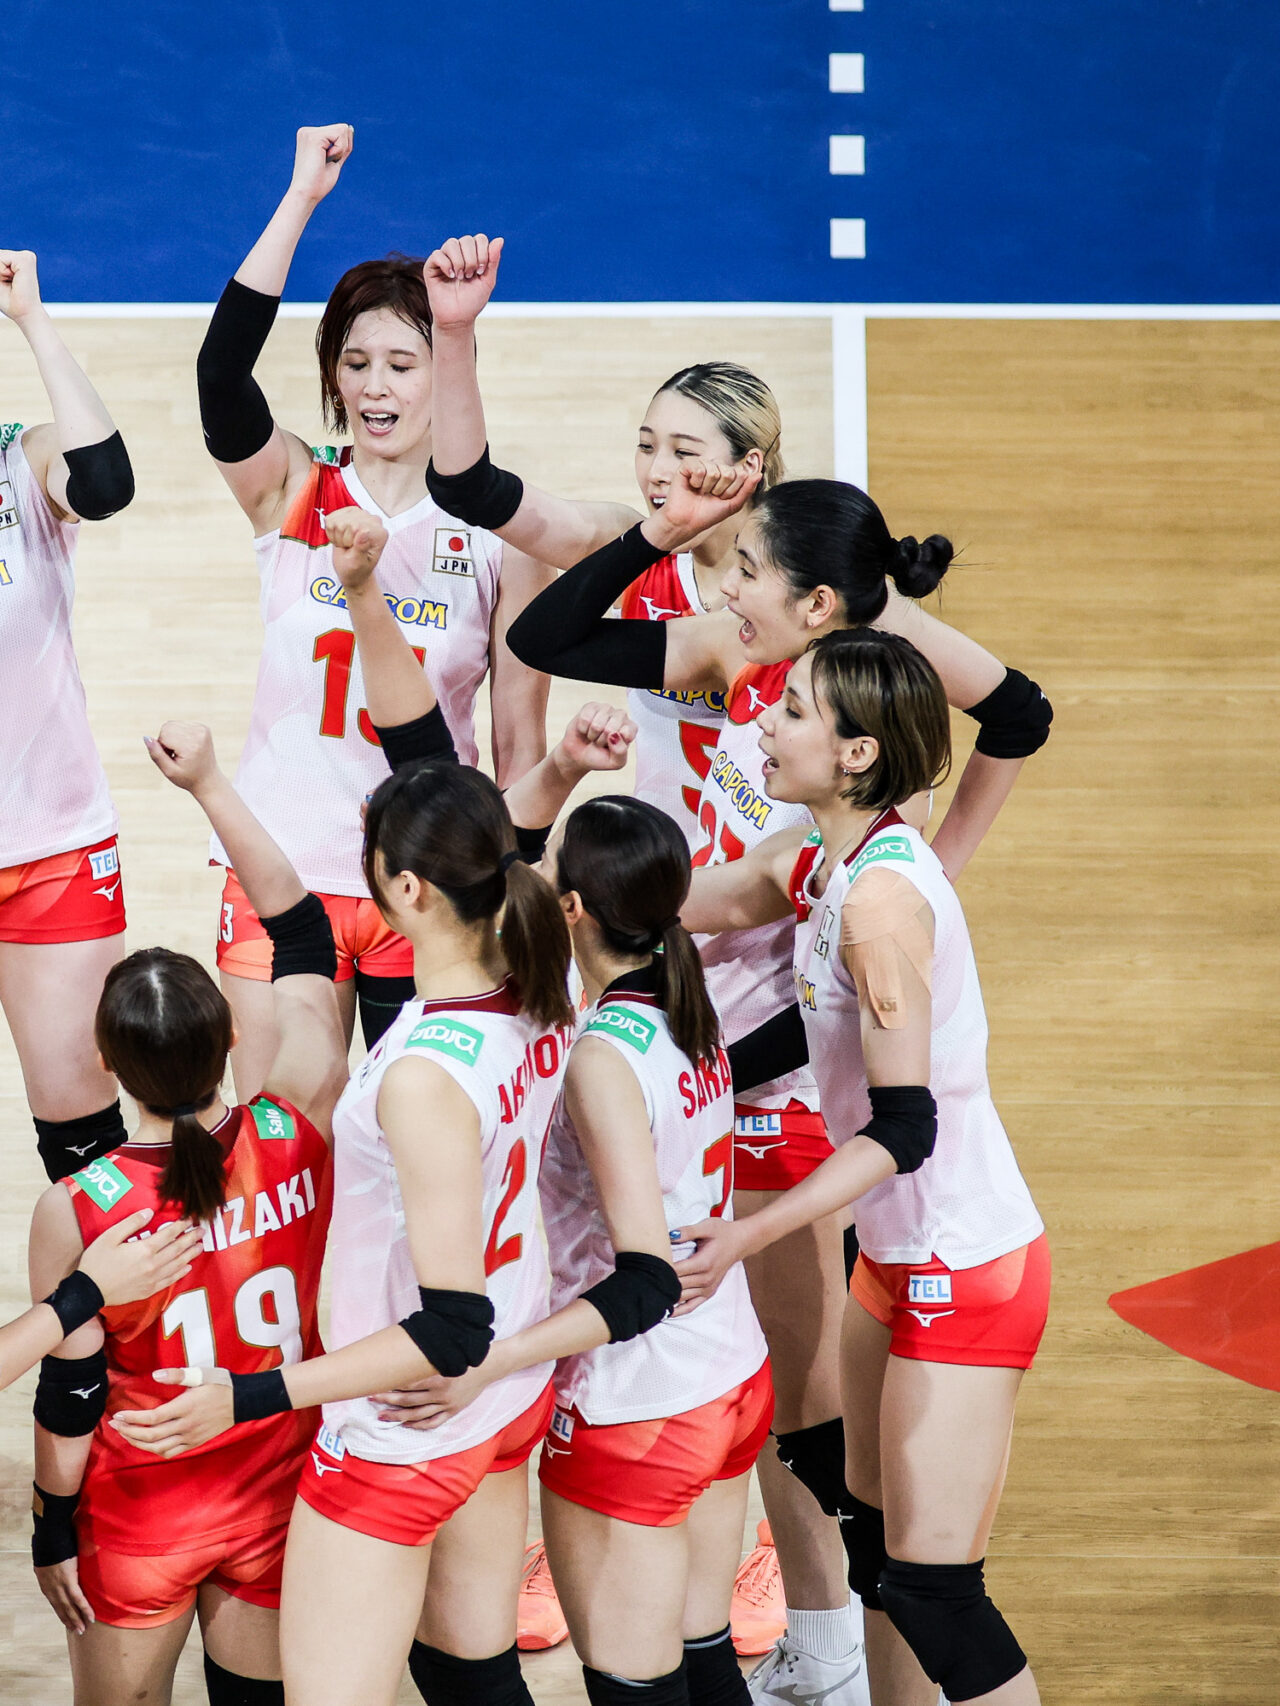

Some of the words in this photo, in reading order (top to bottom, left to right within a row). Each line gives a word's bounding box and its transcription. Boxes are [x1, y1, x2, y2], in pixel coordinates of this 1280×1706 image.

[440, 558, 469, 575] JPN
[310, 577, 448, 630] CACOM
[312, 627, 426, 747] 1
[712, 751, 772, 831] CAPCOM
[92, 852, 117, 873] TEL
[737, 1114, 779, 1131] TEL
[485, 1136, 527, 1278] 2
[911, 1280, 949, 1297] TEL
[162, 1265, 304, 1367] 19
